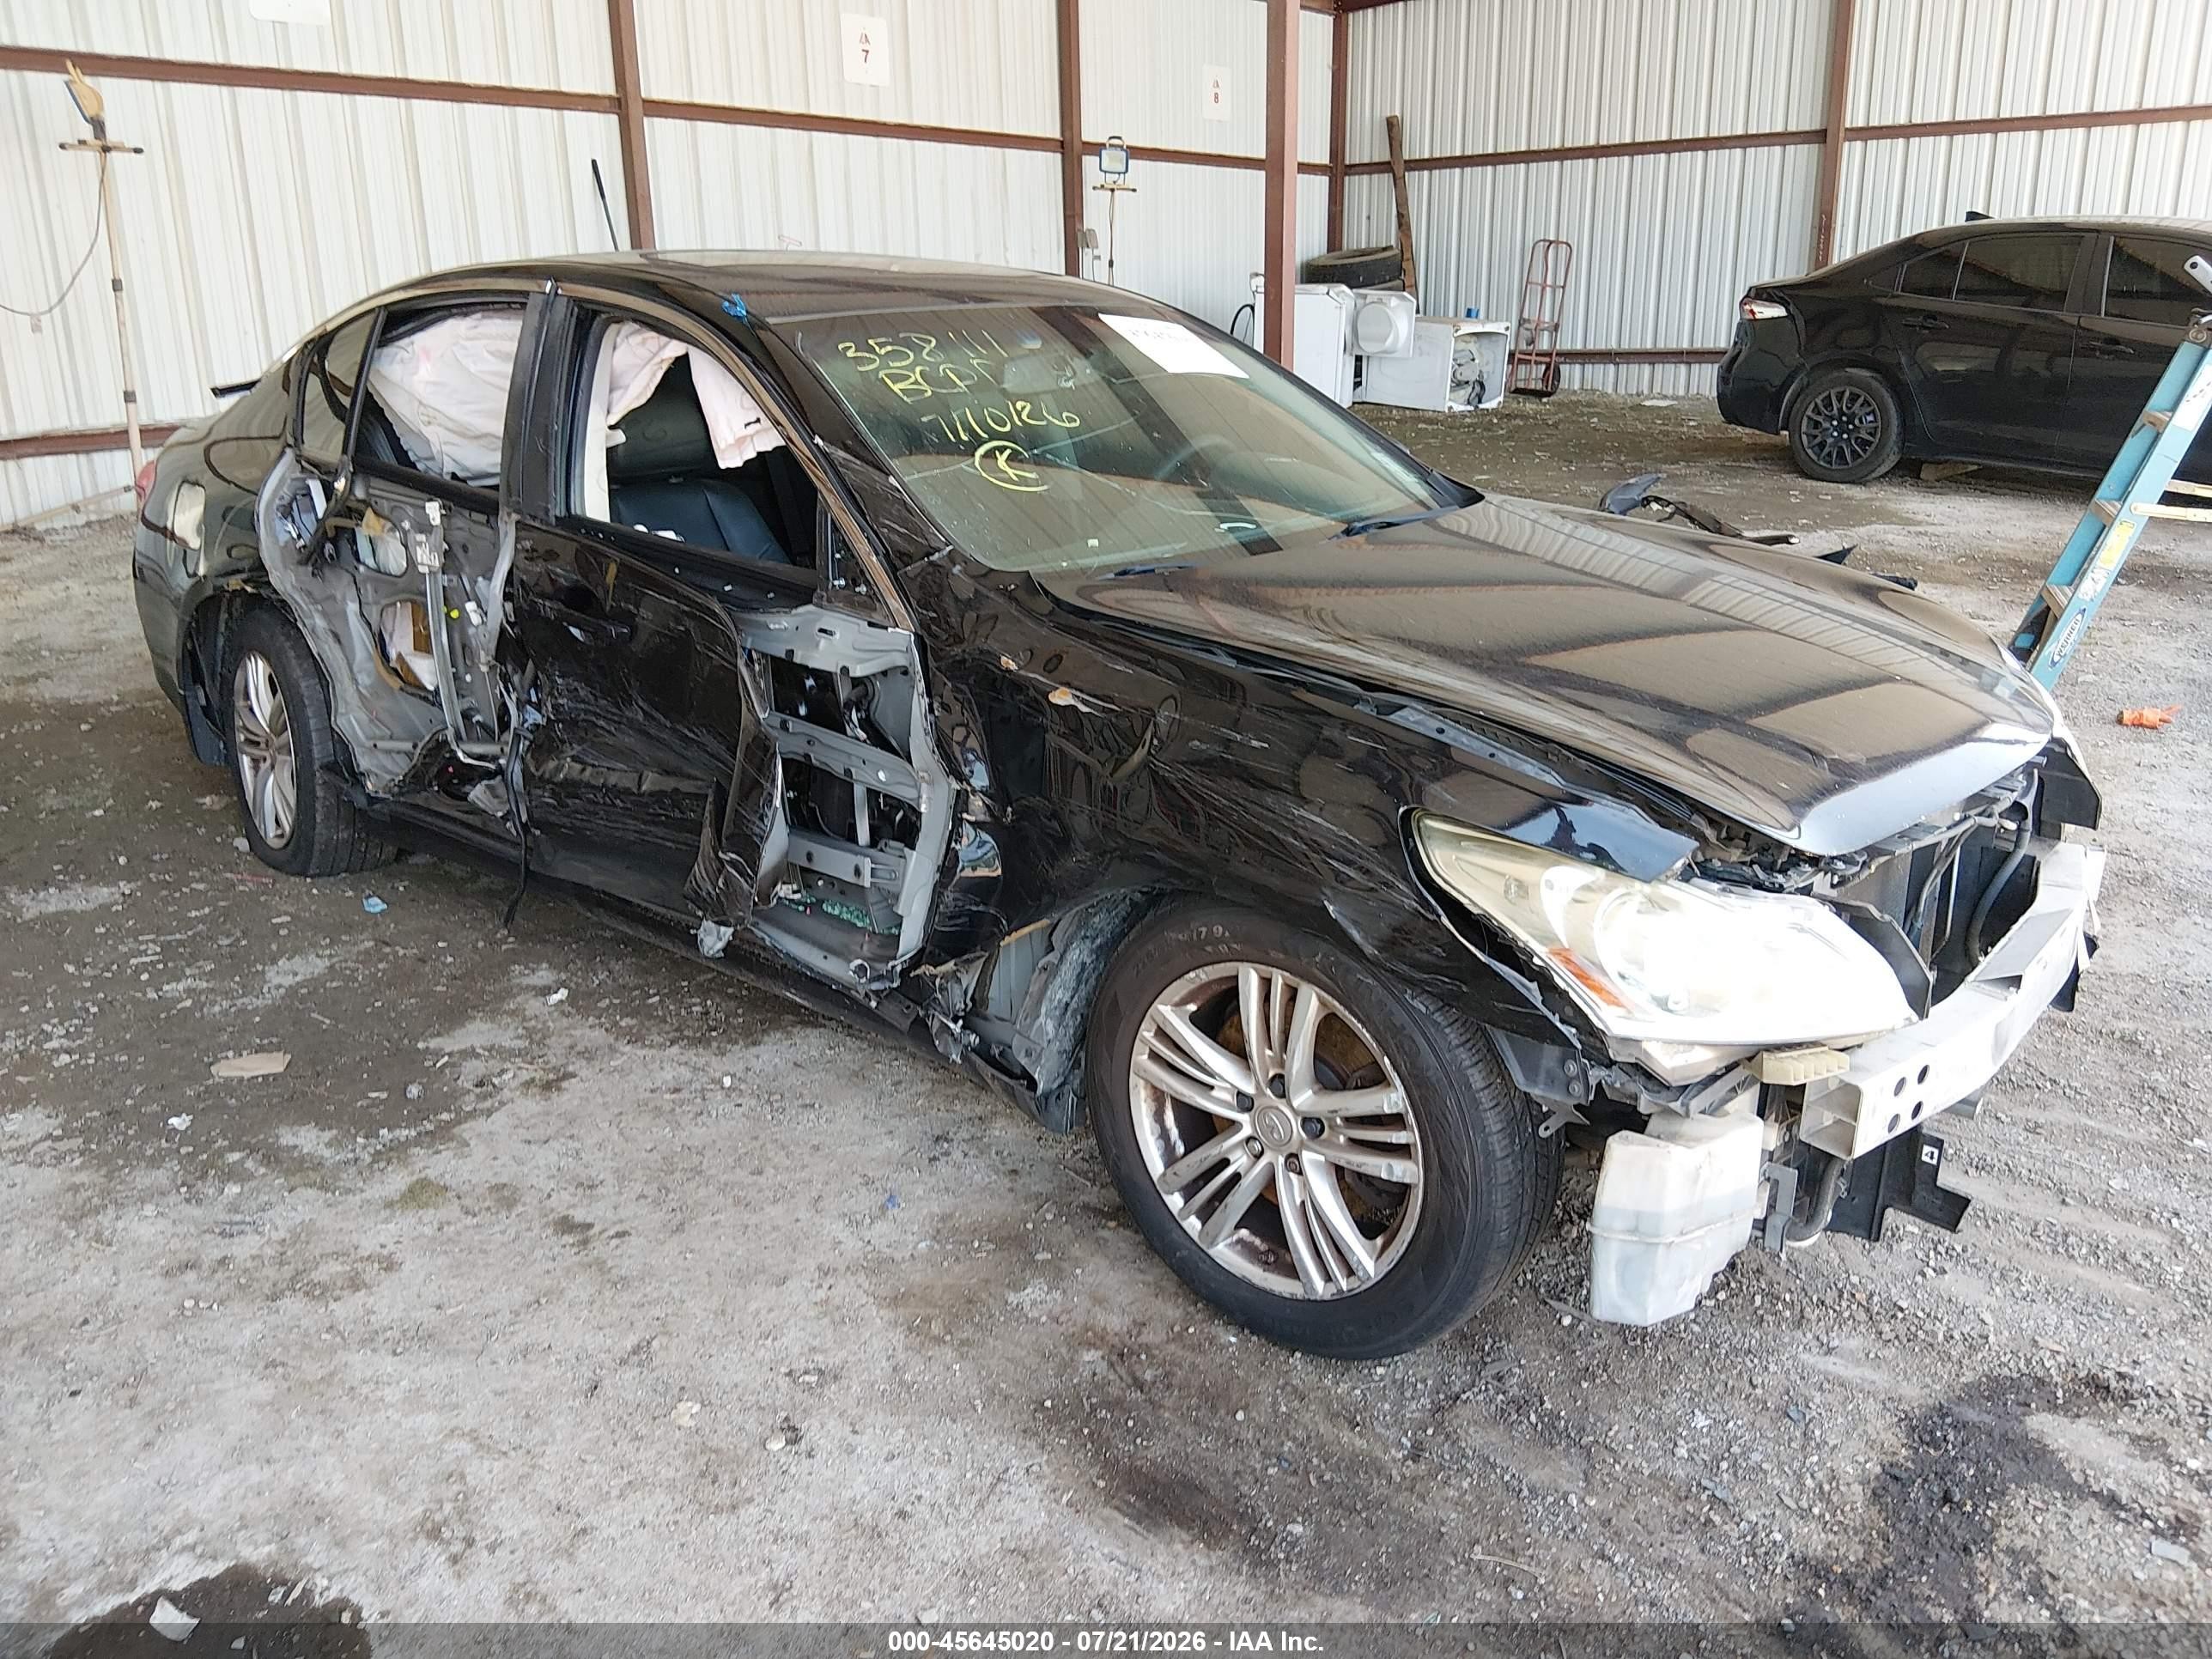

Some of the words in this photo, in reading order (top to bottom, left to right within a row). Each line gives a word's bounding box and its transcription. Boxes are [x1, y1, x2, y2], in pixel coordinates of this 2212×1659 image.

[861, 48, 869, 64] 7
[1213, 92, 1219, 104] 8
[1924, 1150, 1936, 1162] 4
